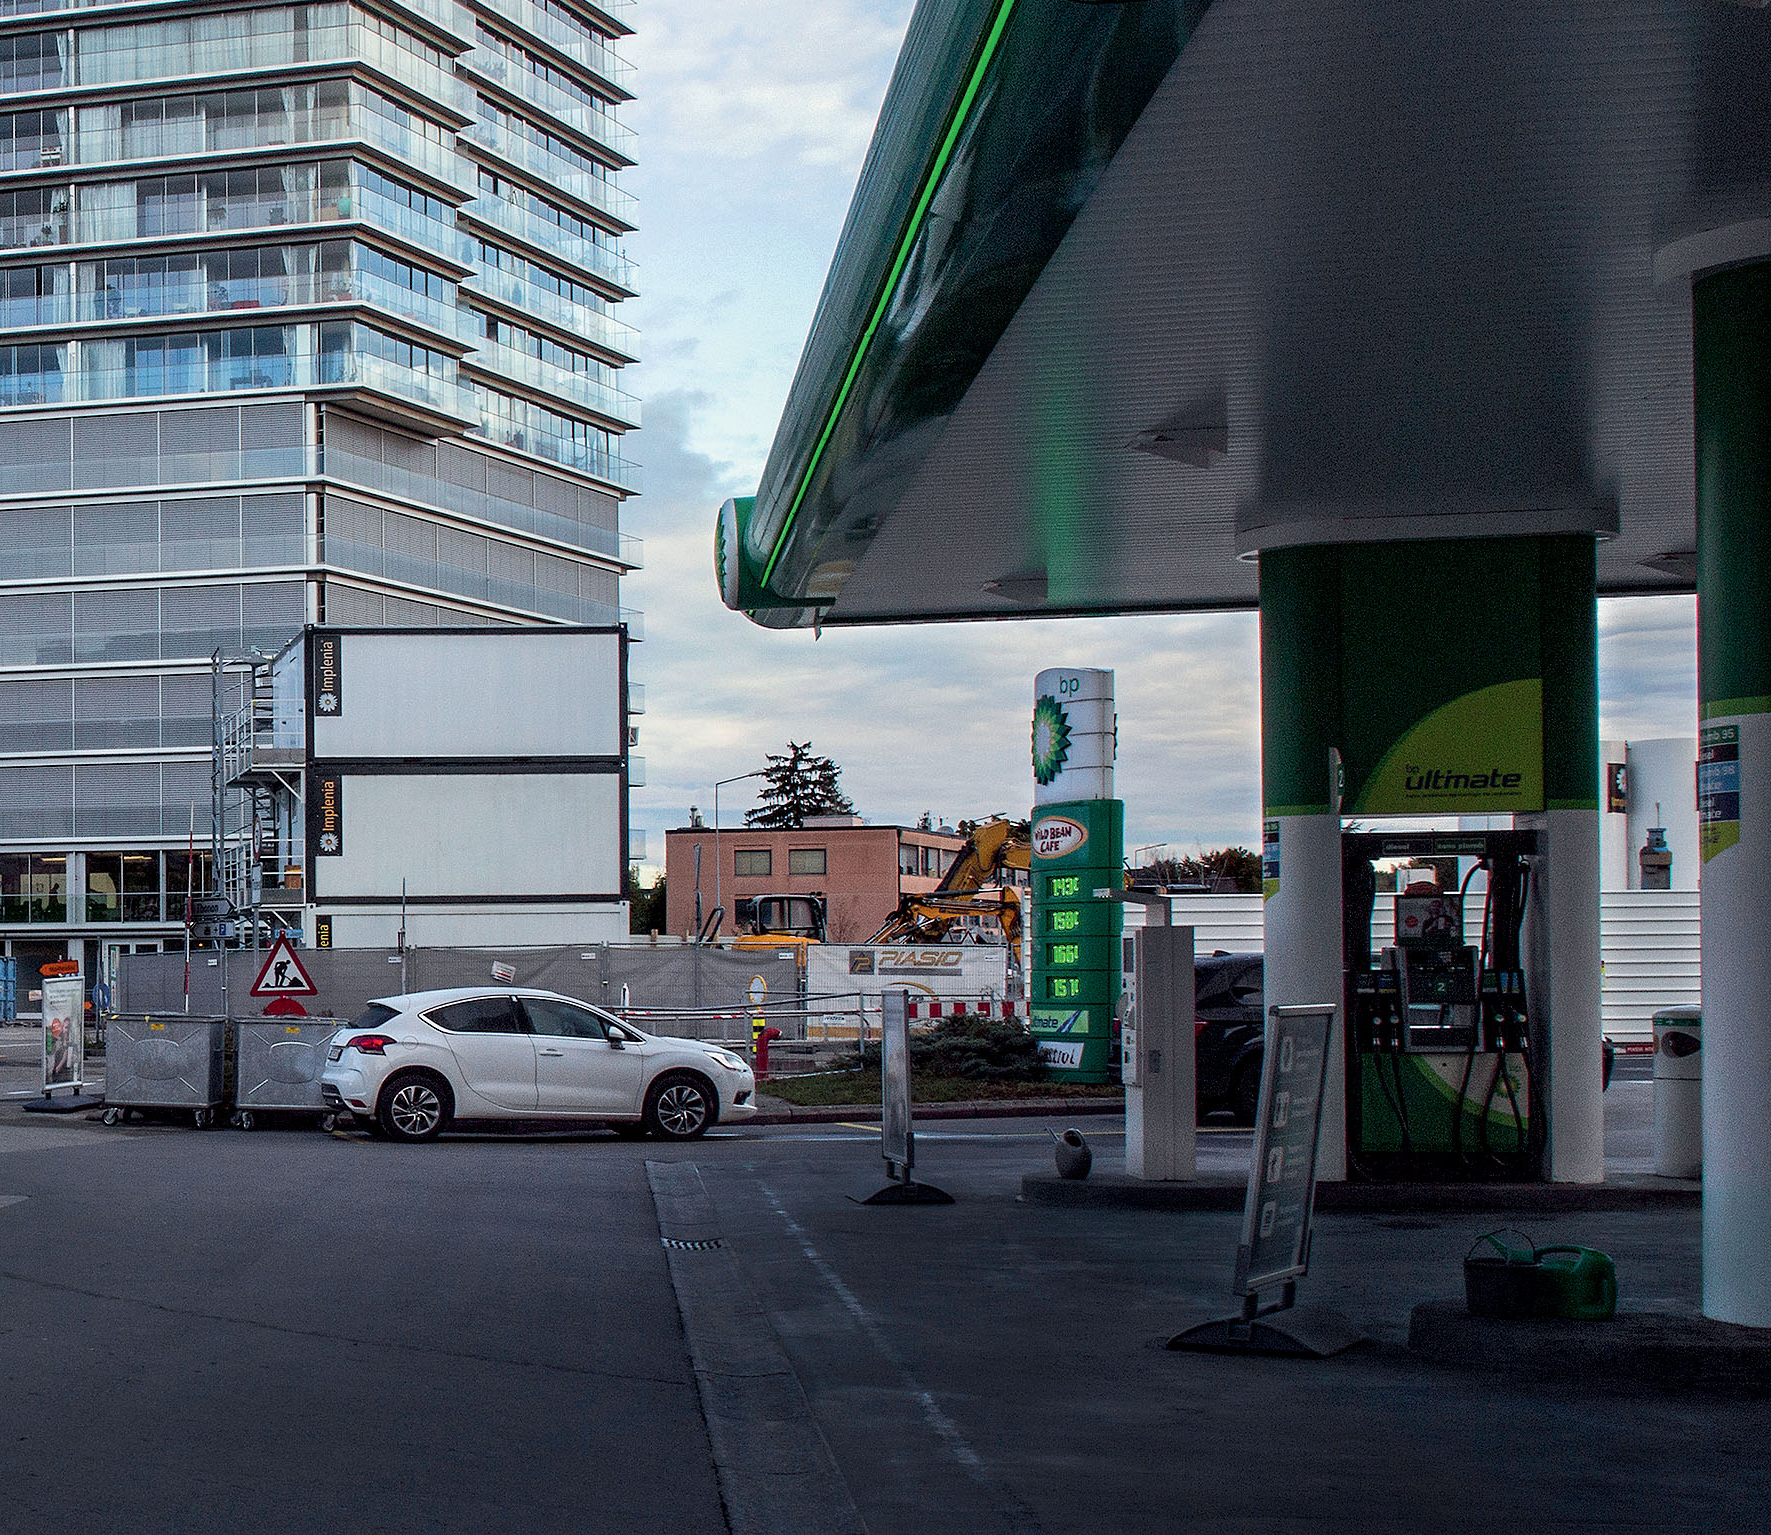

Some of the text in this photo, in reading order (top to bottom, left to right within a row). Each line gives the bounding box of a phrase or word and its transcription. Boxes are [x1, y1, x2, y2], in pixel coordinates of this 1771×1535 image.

[321, 640, 338, 692] Implenia
[1059, 675, 1079, 696] bp
[1405, 768, 1522, 790] ultimate
[321, 780, 338, 832] Implenia
[1049, 826, 1072, 840] BEAN
[318, 924, 330, 947] enia
[878, 951, 963, 966] PIASIO
